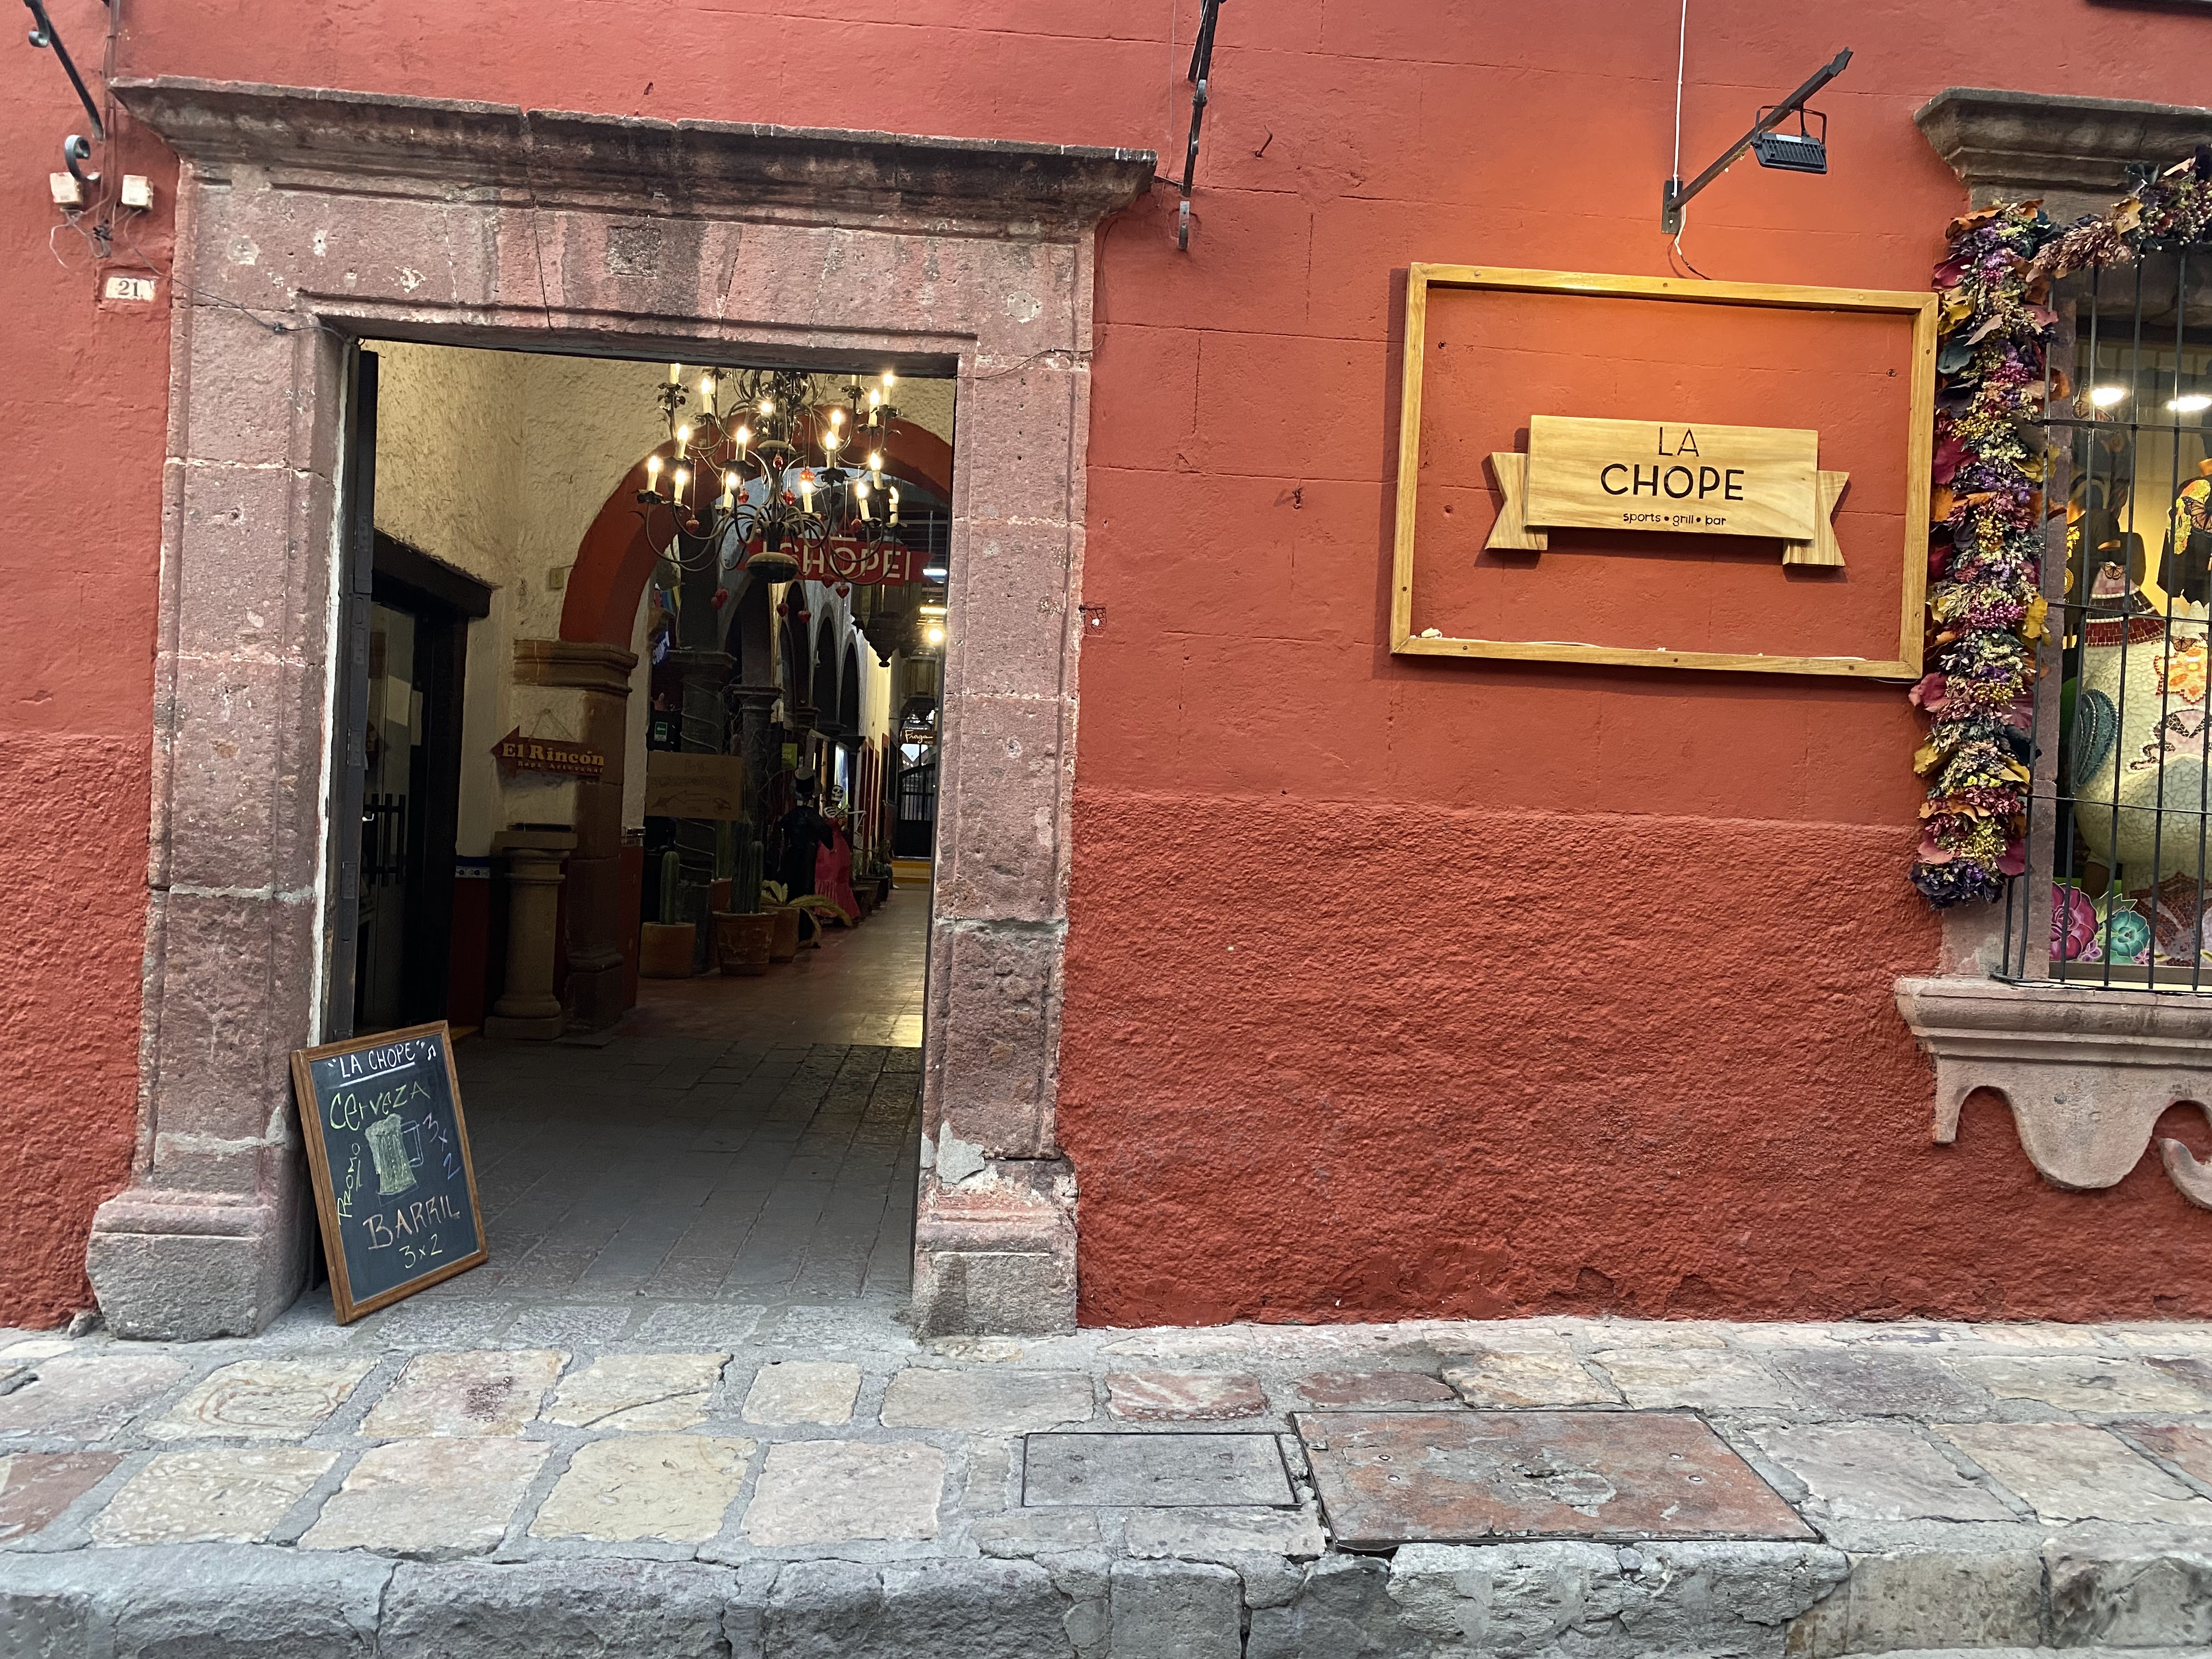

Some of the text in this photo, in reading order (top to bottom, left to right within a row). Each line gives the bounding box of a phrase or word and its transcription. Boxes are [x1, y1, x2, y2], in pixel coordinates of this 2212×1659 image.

[1658, 426, 1700, 456] LA
[1601, 463, 1745, 501] CHOPE
[1623, 513, 1726, 526] sports grill bar
[502, 743, 605, 766] El Rincón
[363, 1195, 460, 1250] BARRIL
